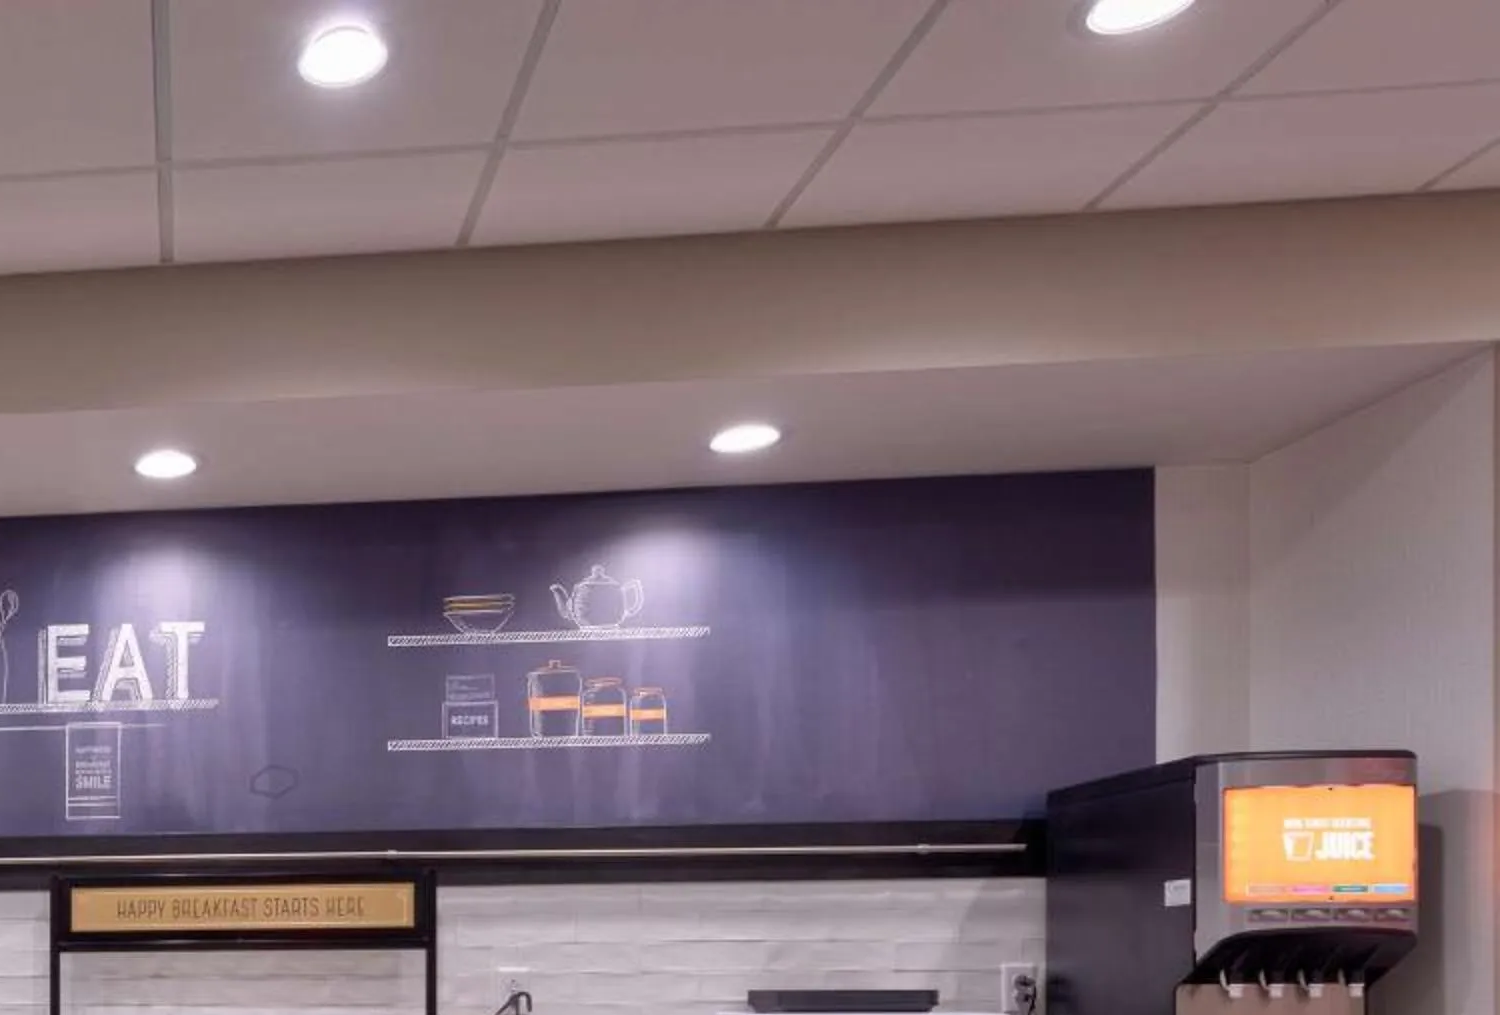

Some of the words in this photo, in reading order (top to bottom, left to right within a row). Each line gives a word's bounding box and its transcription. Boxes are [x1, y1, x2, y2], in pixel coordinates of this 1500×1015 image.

[38, 621, 205, 702] EAT
[451, 715, 489, 725] RECIPES
[75, 775, 112, 790] SMILE
[1314, 831, 1374, 860] JUICE
[117, 899, 164, 919] HAPPY
[172, 897, 257, 918] BREAKFAST
[263, 897, 319, 917] STARTS
[326, 896, 364, 917] HERE
